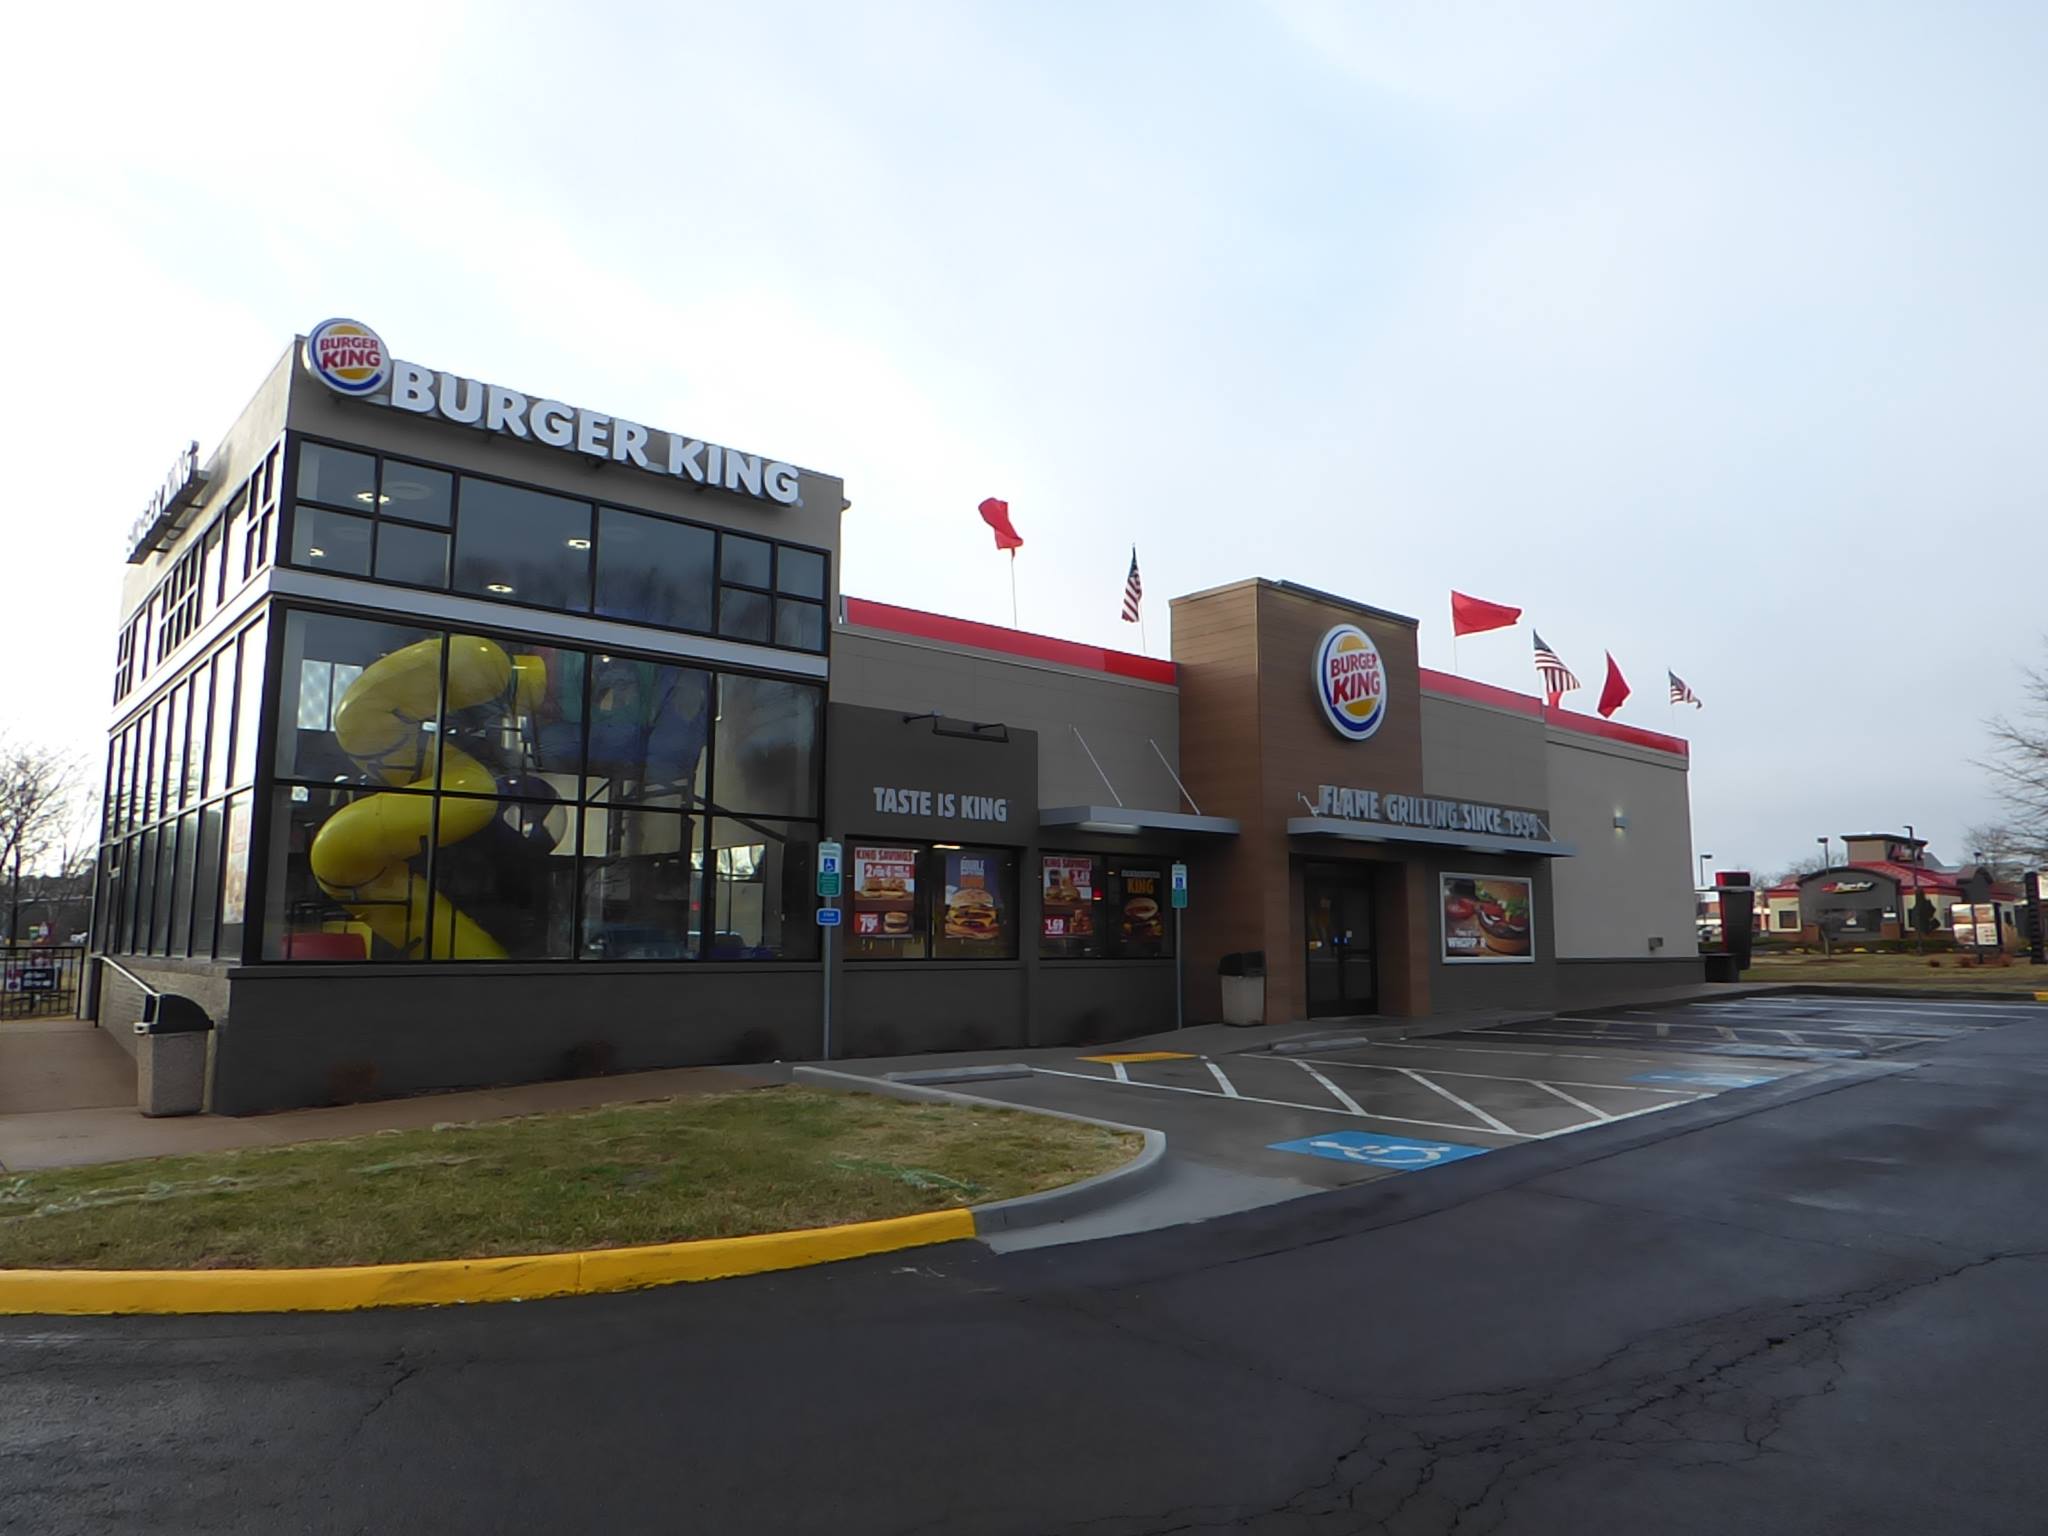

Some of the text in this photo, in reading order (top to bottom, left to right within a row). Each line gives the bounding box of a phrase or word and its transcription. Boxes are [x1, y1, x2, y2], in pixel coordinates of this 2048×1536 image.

[320, 337, 378, 351] BURGER
[323, 350, 381, 370] KING
[391, 359, 799, 504] BURGER KING
[1330, 652, 1378, 678] BURGER
[1333, 670, 1381, 705] KING
[873, 786, 1007, 822] TASTE IS KING
[1318, 784, 1380, 820] FLAME
[1384, 793, 1458, 830] GRILLING
[1459, 803, 1501, 834] SINCE
[1447, 937, 1486, 948] WHOPPR
